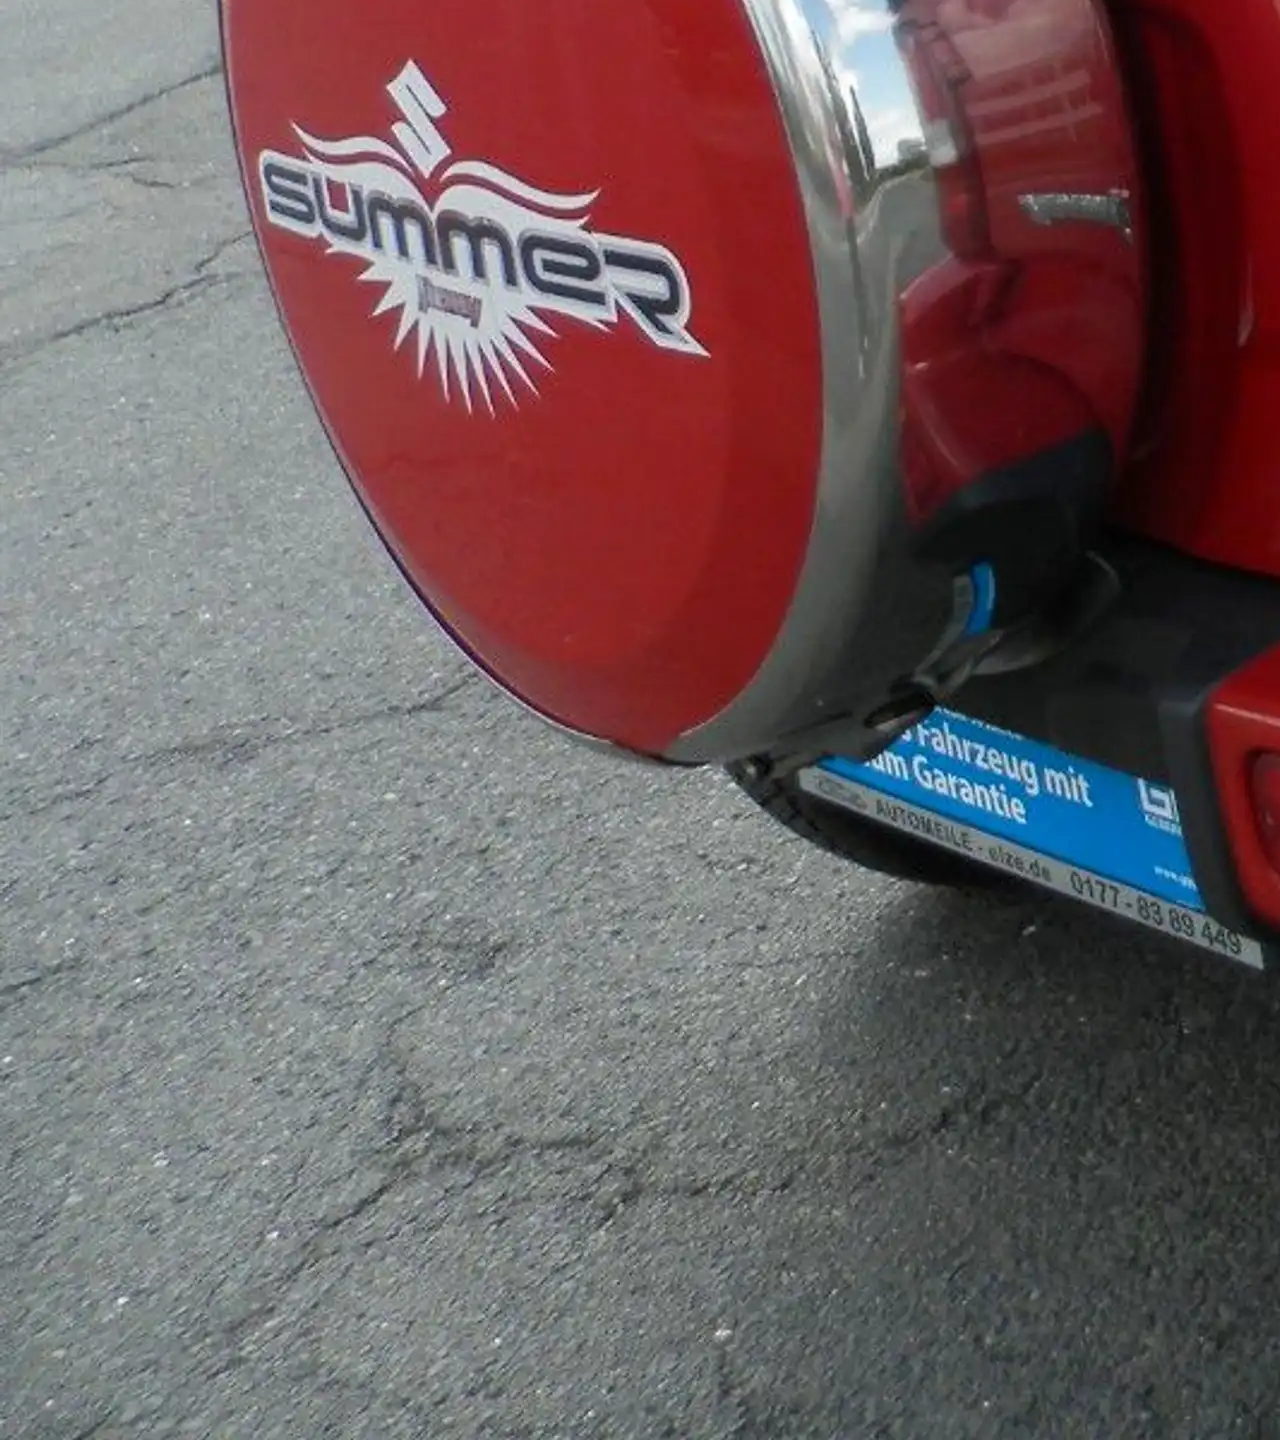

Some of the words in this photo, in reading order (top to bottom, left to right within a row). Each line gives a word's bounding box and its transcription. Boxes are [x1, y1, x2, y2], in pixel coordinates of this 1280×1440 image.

[912, 755, 1027, 825] Garantie
[1044, 765, 1094, 807] mit
[876, 799, 973, 851] AUTOMEILE
[1070, 871, 1120, 908] 0177
[1136, 894, 1164, 927] 83
[1169, 908, 1195, 937] 89
[1202, 921, 1242, 956] 449
